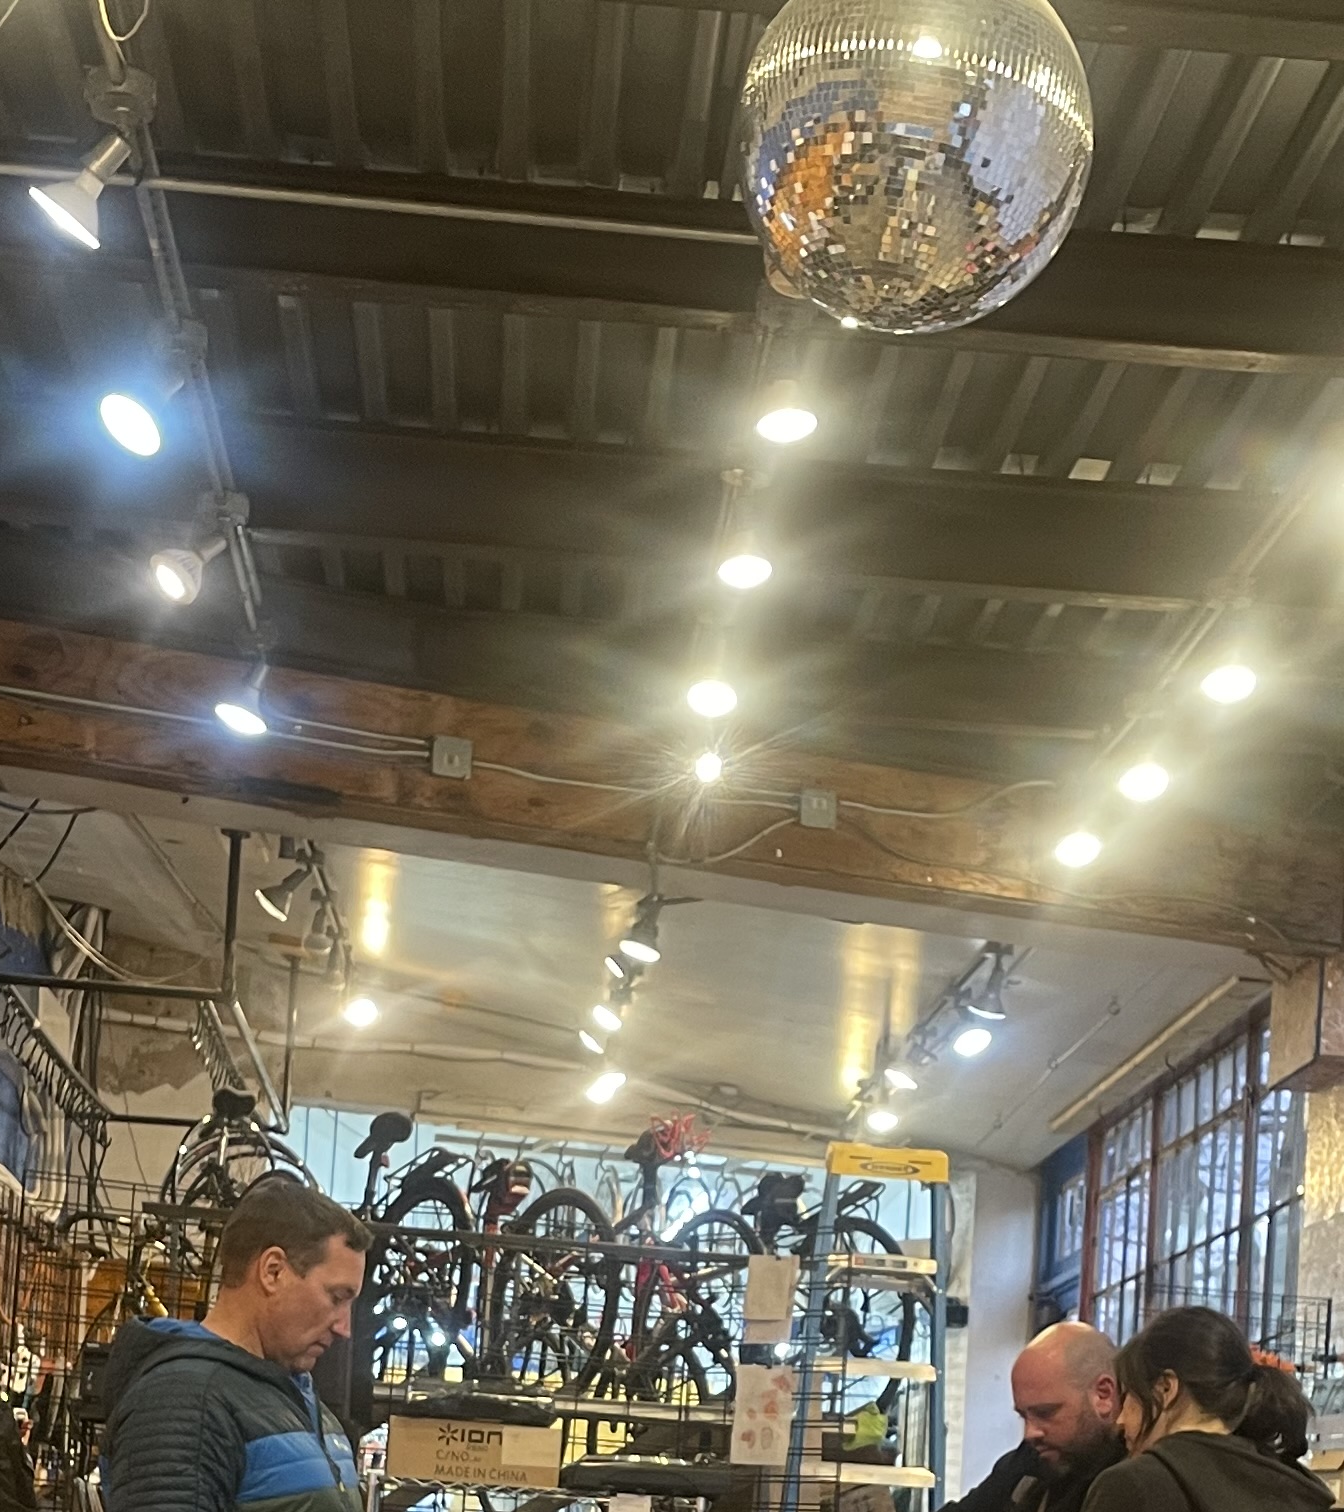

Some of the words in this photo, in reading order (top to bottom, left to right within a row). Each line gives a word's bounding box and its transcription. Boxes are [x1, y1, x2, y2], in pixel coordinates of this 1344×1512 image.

[434, 1464, 471, 1479] MADE
[473, 1469, 487, 1480] IN
[488, 1469, 529, 1483] CHINA
